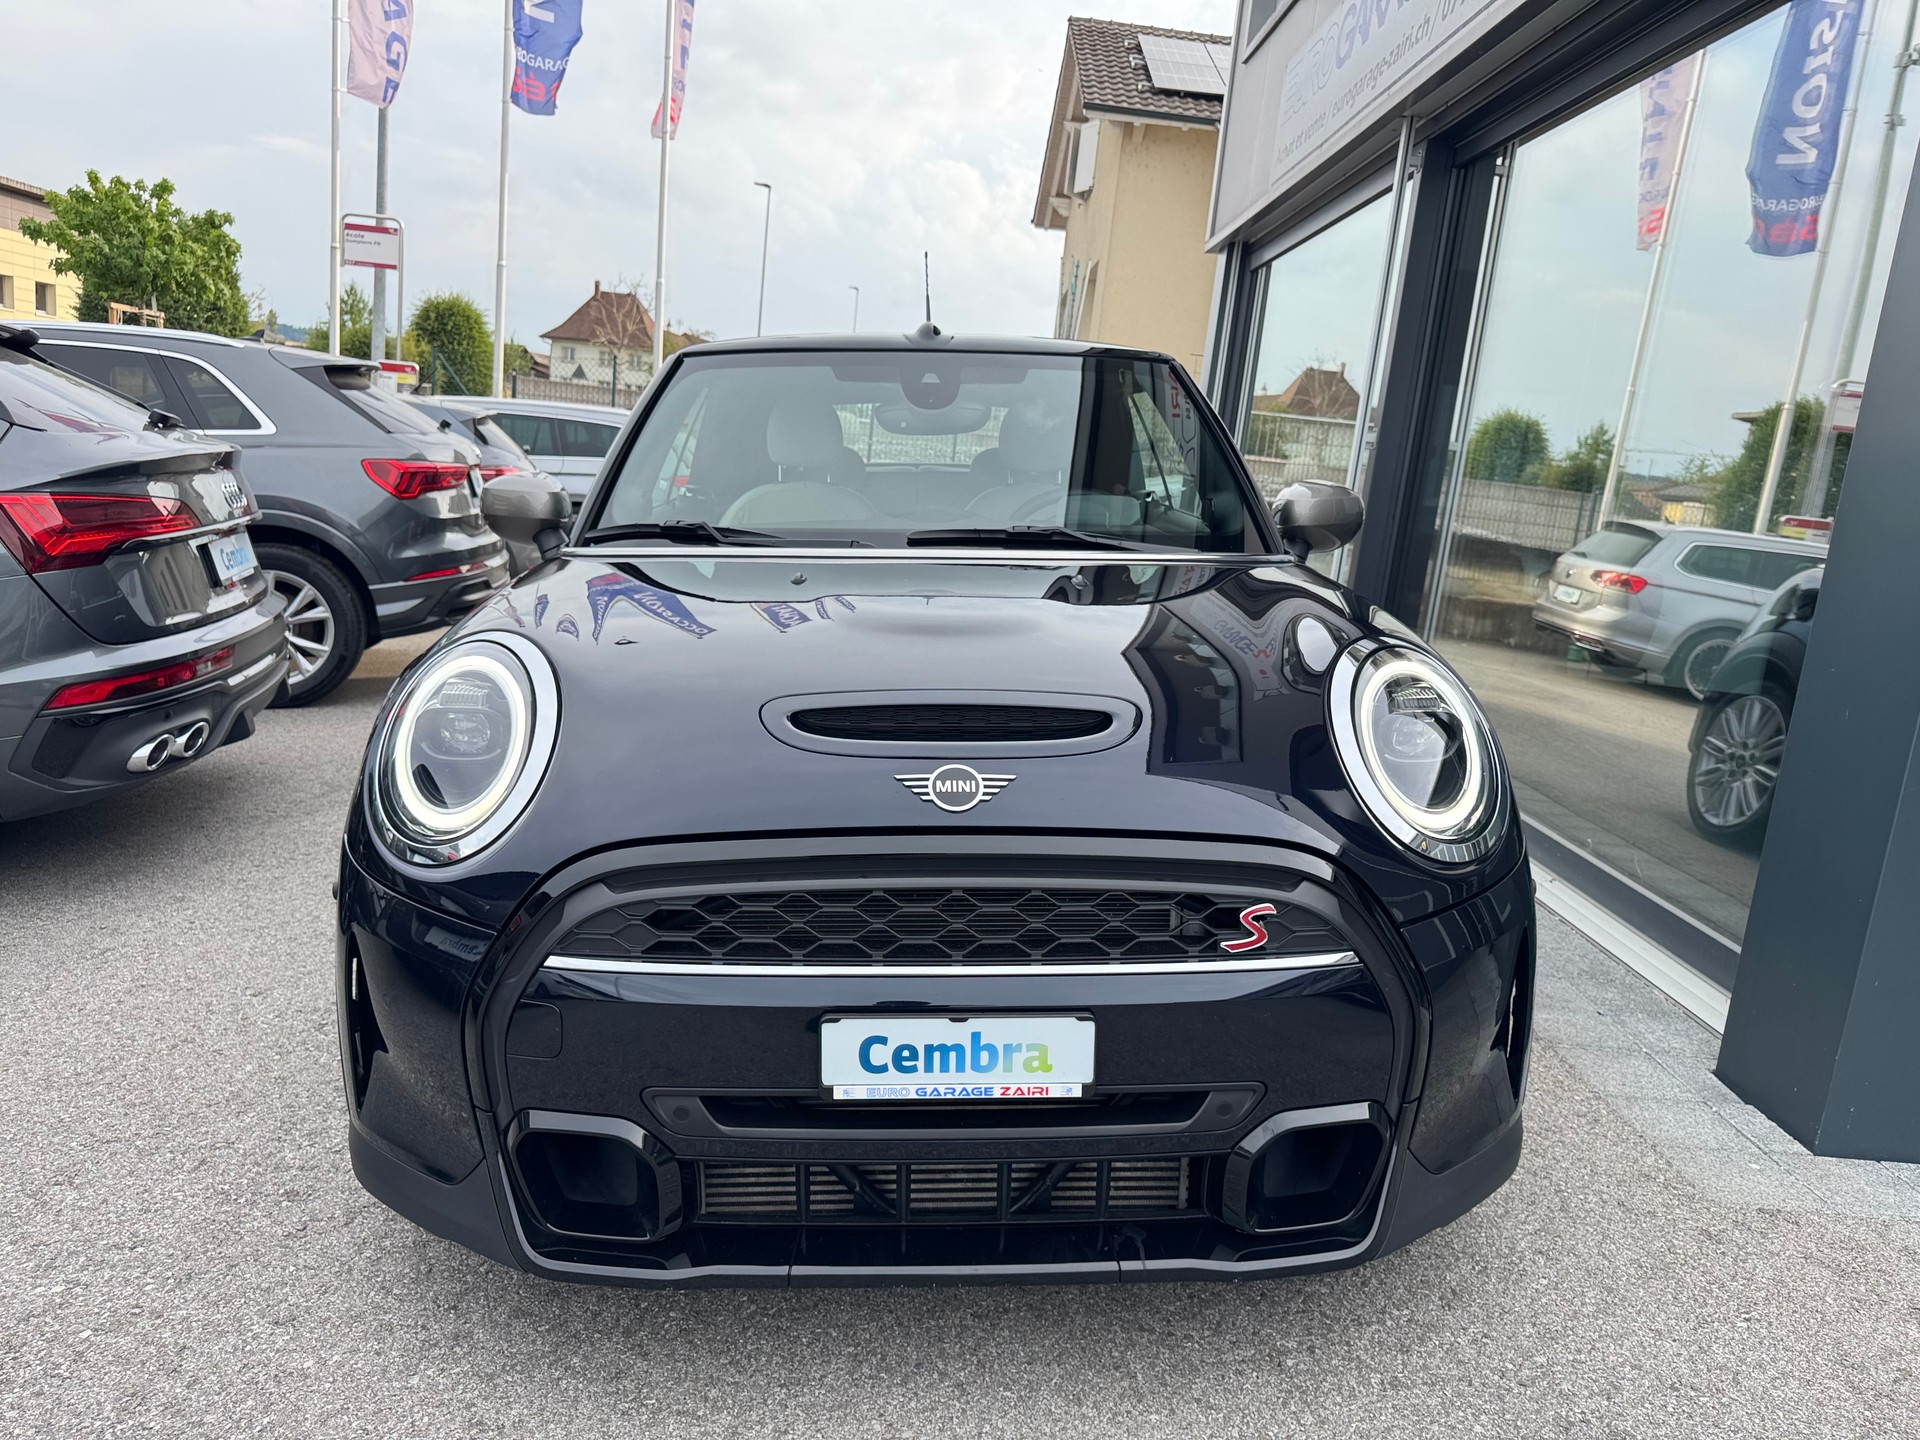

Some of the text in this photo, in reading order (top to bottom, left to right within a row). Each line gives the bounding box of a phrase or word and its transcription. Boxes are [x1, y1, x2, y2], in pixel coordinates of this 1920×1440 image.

[936, 780, 976, 793] MINI
[1220, 903, 1277, 953] S
[858, 1031, 1053, 1075] Cembra
[866, 1086, 1049, 1098] EURO GARAGE ZAIRI
